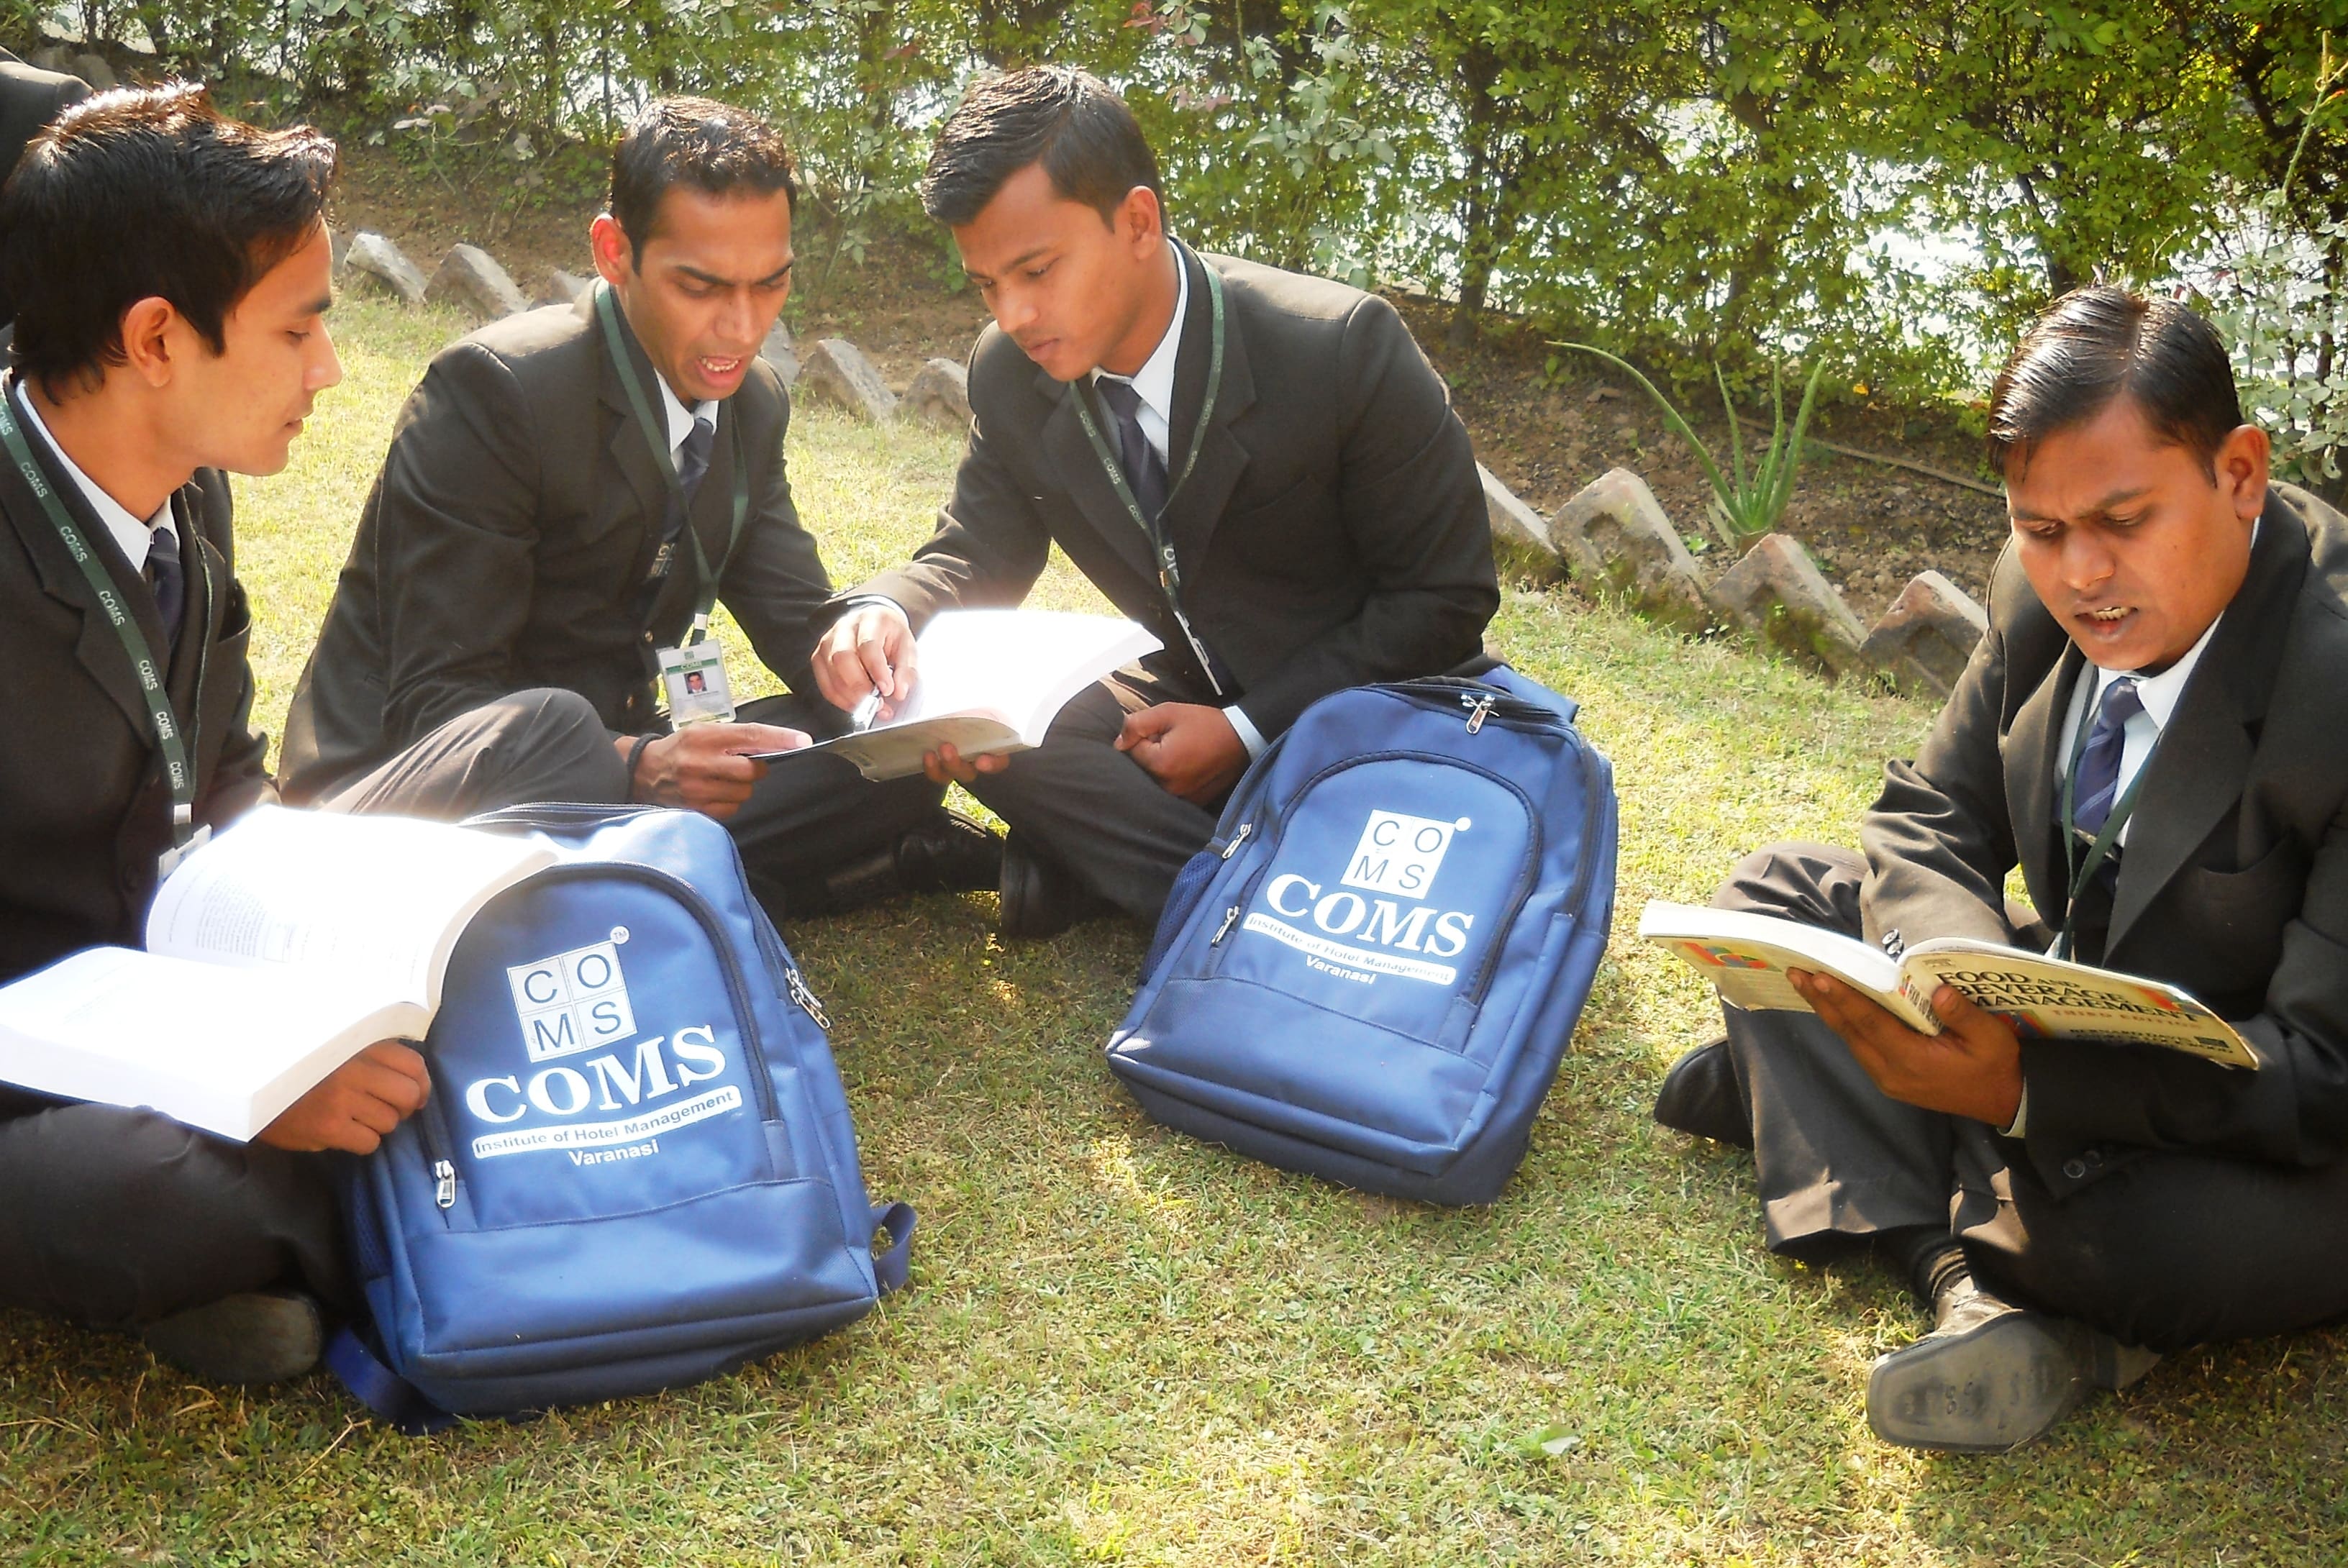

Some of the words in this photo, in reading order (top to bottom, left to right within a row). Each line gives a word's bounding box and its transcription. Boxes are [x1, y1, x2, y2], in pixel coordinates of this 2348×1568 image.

[0, 405, 14, 436] OMS
[20, 462, 48, 498] COMS
[1103, 457, 1121, 485] COMS
[60, 526, 88, 562] COMS
[98, 590, 125, 626] COMS
[138, 659, 158, 690] COMS
[155, 711, 174, 740] COMS
[169, 761, 185, 790] COMS
[1266, 873, 1475, 957] COMS
[1249, 916, 1303, 944] Institute
[1307, 942, 1320, 950] of
[1324, 945, 1360, 962] Hotel
[1363, 956, 1451, 982] Management
[1306, 954, 1378, 985] Varanasi
[1935, 970, 2030, 984] FOOD
[2037, 977, 2080, 988] AND
[1952, 983, 2129, 1003] BEVERAGE
[466, 1024, 727, 1123] COMS
[475, 1134, 547, 1154] Institute
[553, 1130, 570, 1143] of
[575, 1126, 619, 1141] Hotel
[624, 1090, 734, 1135] Management
[568, 1138, 660, 1167] Varanasi
